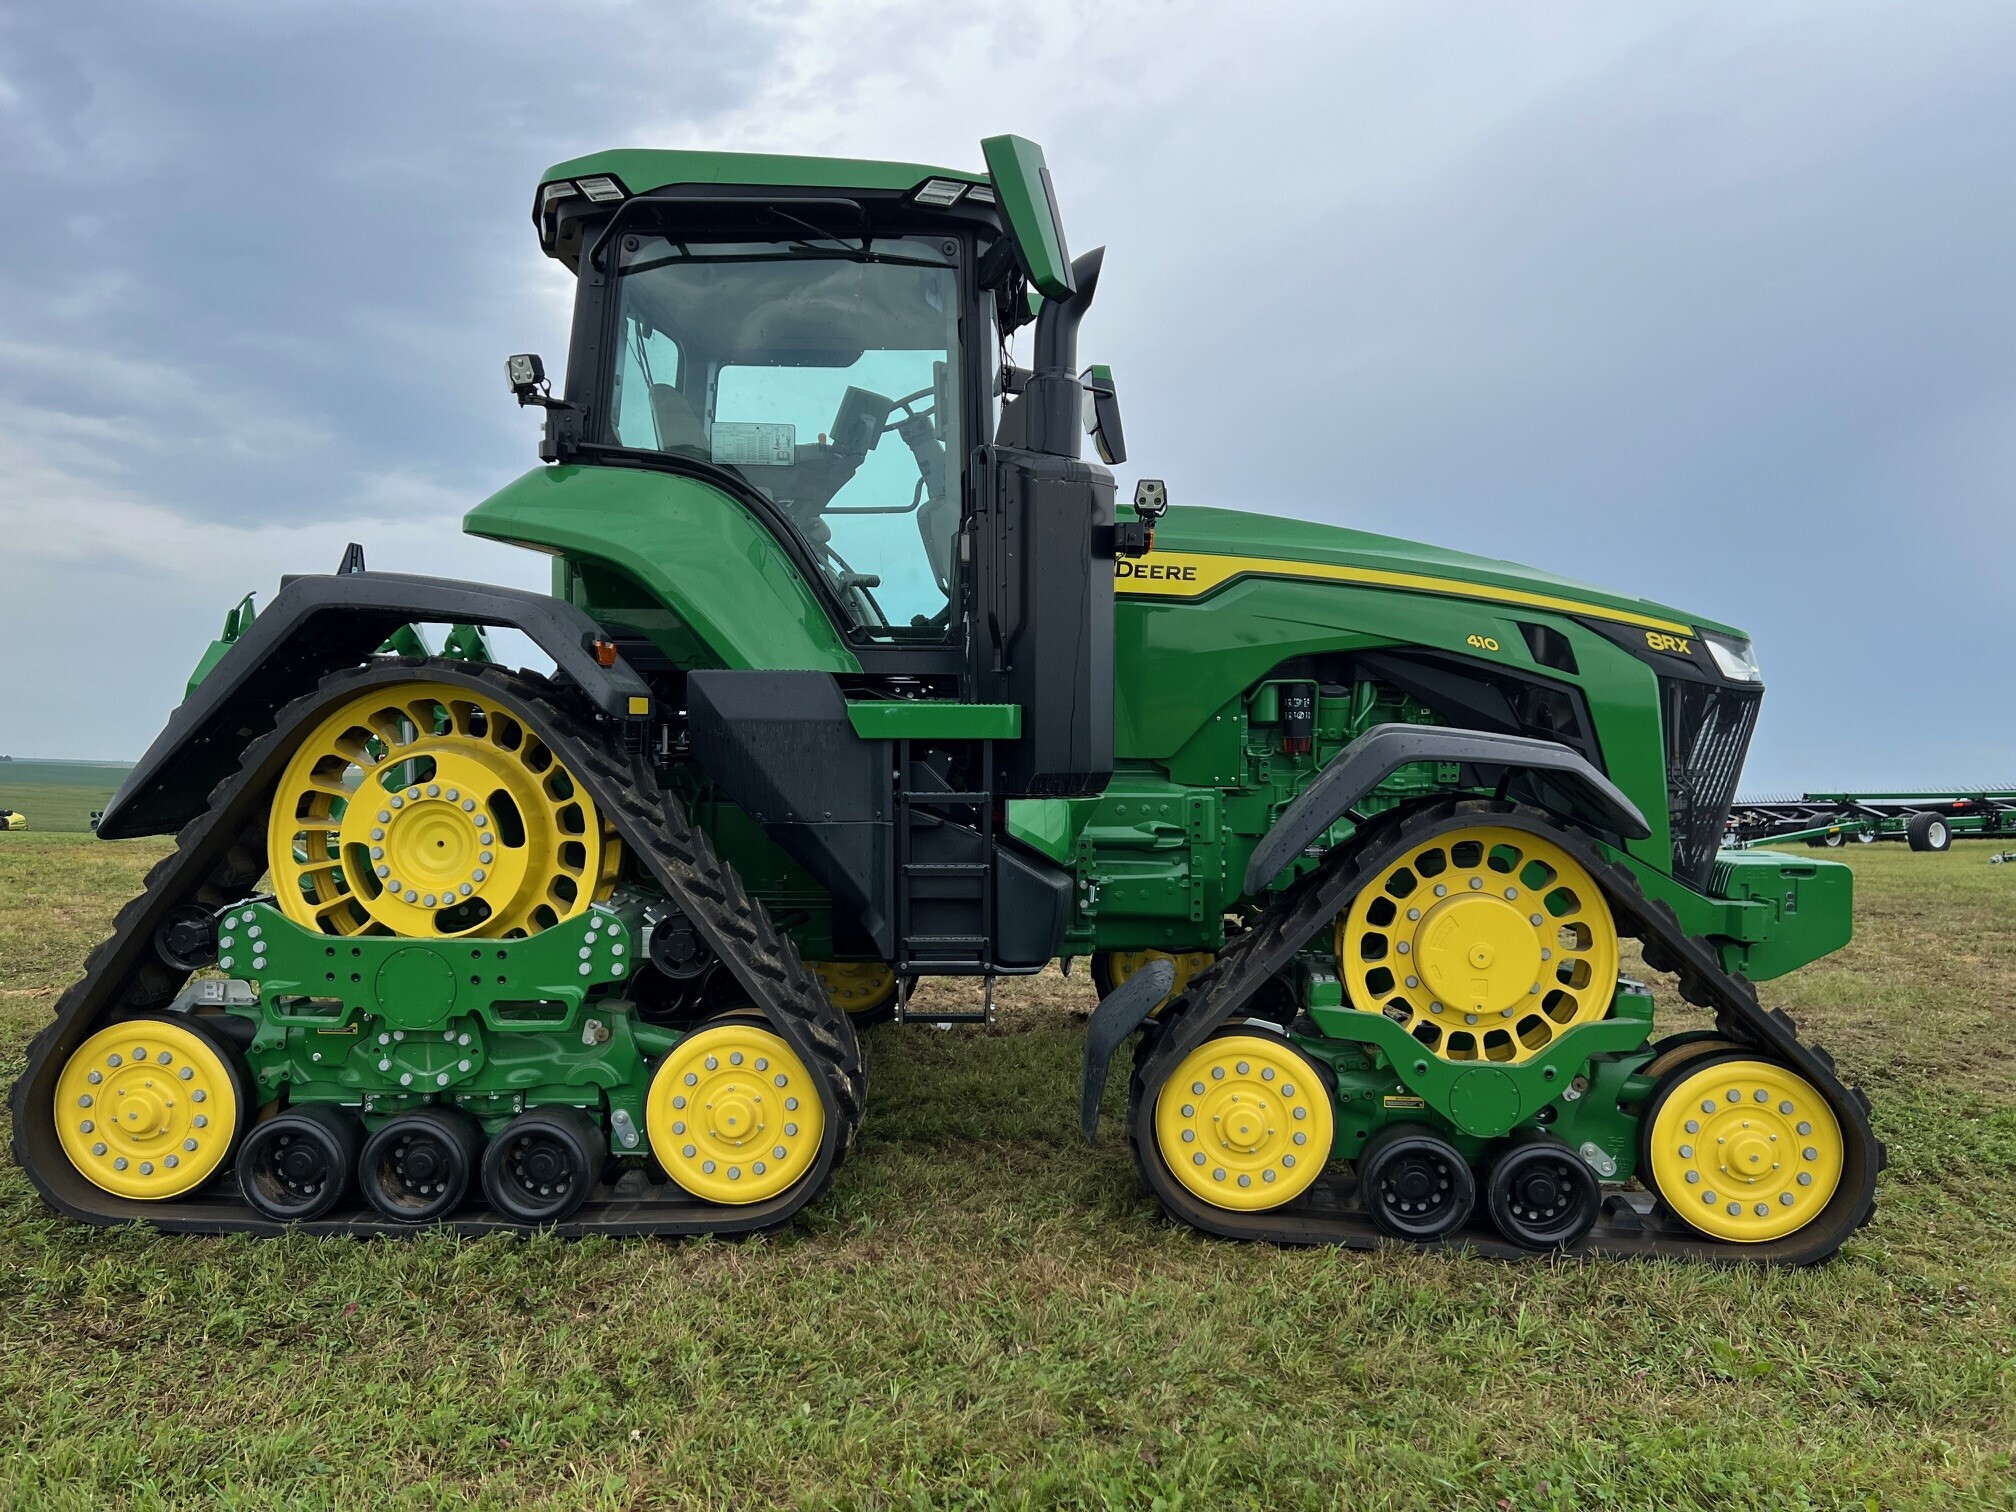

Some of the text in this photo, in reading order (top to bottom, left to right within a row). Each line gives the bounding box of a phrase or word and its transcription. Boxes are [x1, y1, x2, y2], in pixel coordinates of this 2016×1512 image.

[1115, 560, 1197, 581] DEERE
[1466, 634, 1499, 652] 410
[1645, 631, 1692, 655] 8RX
